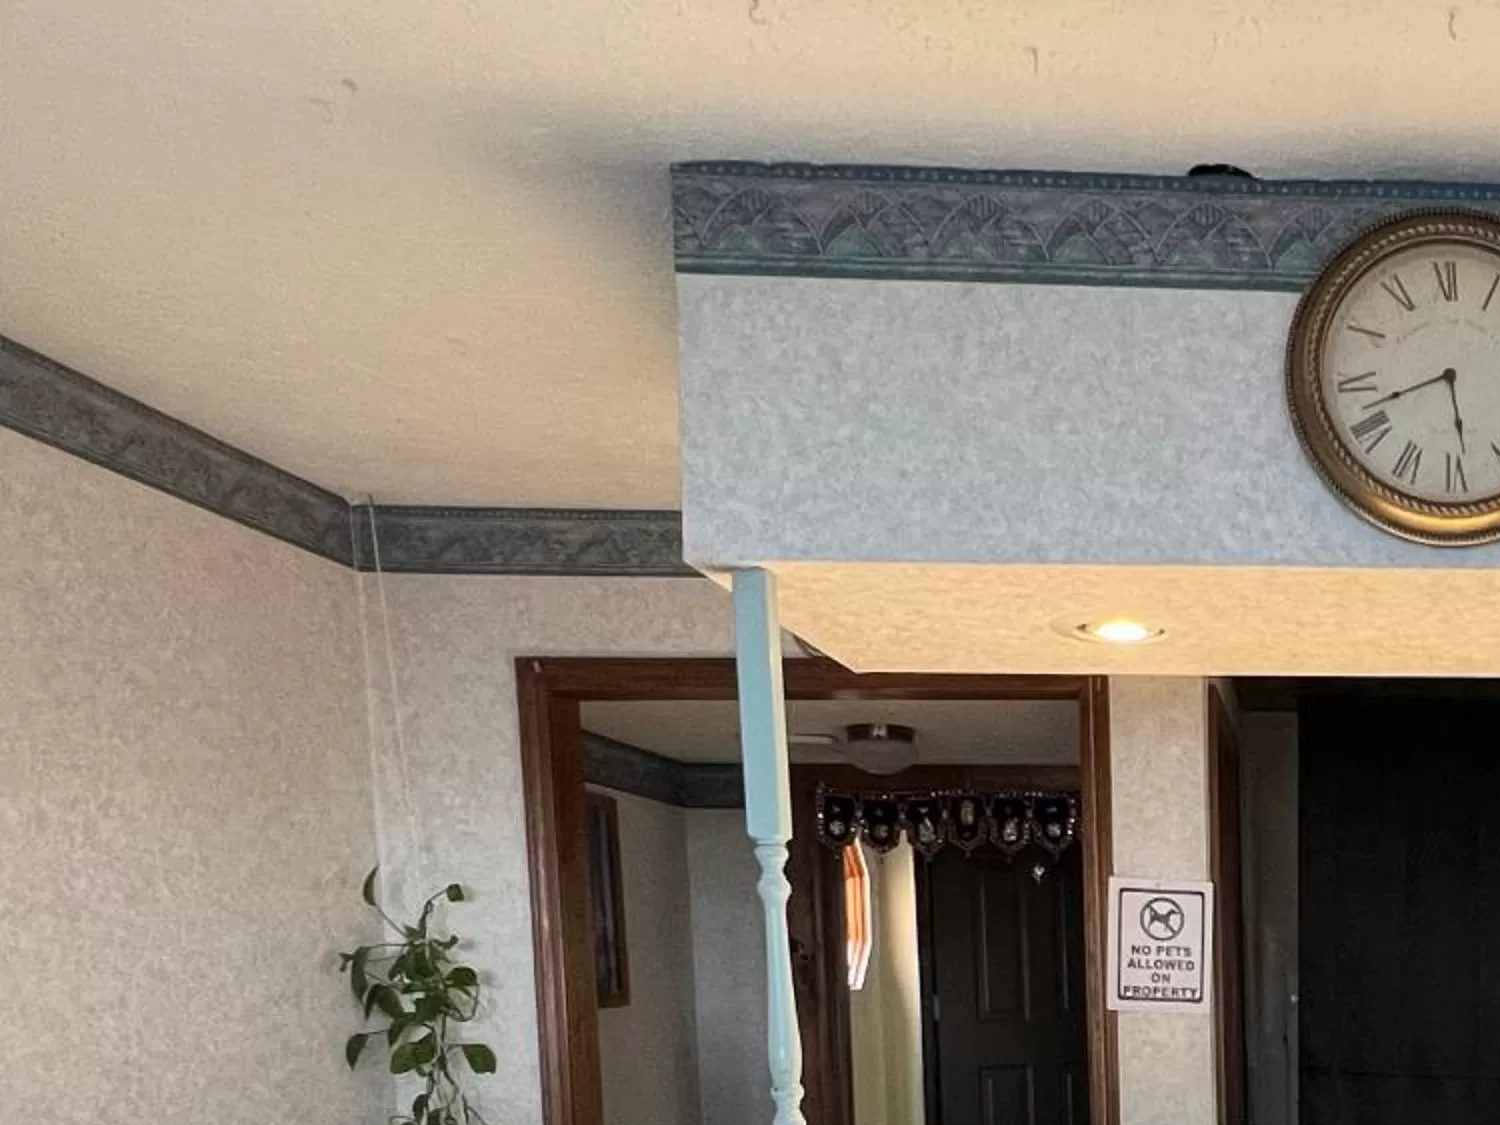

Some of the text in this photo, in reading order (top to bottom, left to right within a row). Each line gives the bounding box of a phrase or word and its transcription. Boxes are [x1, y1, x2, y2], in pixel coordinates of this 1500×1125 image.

[1131, 945, 1193, 957] NO PETS
[1127, 958, 1195, 971] ALLOWED
[1151, 972, 1171, 984] ON
[1123, 985, 1199, 998] PROPERTY
